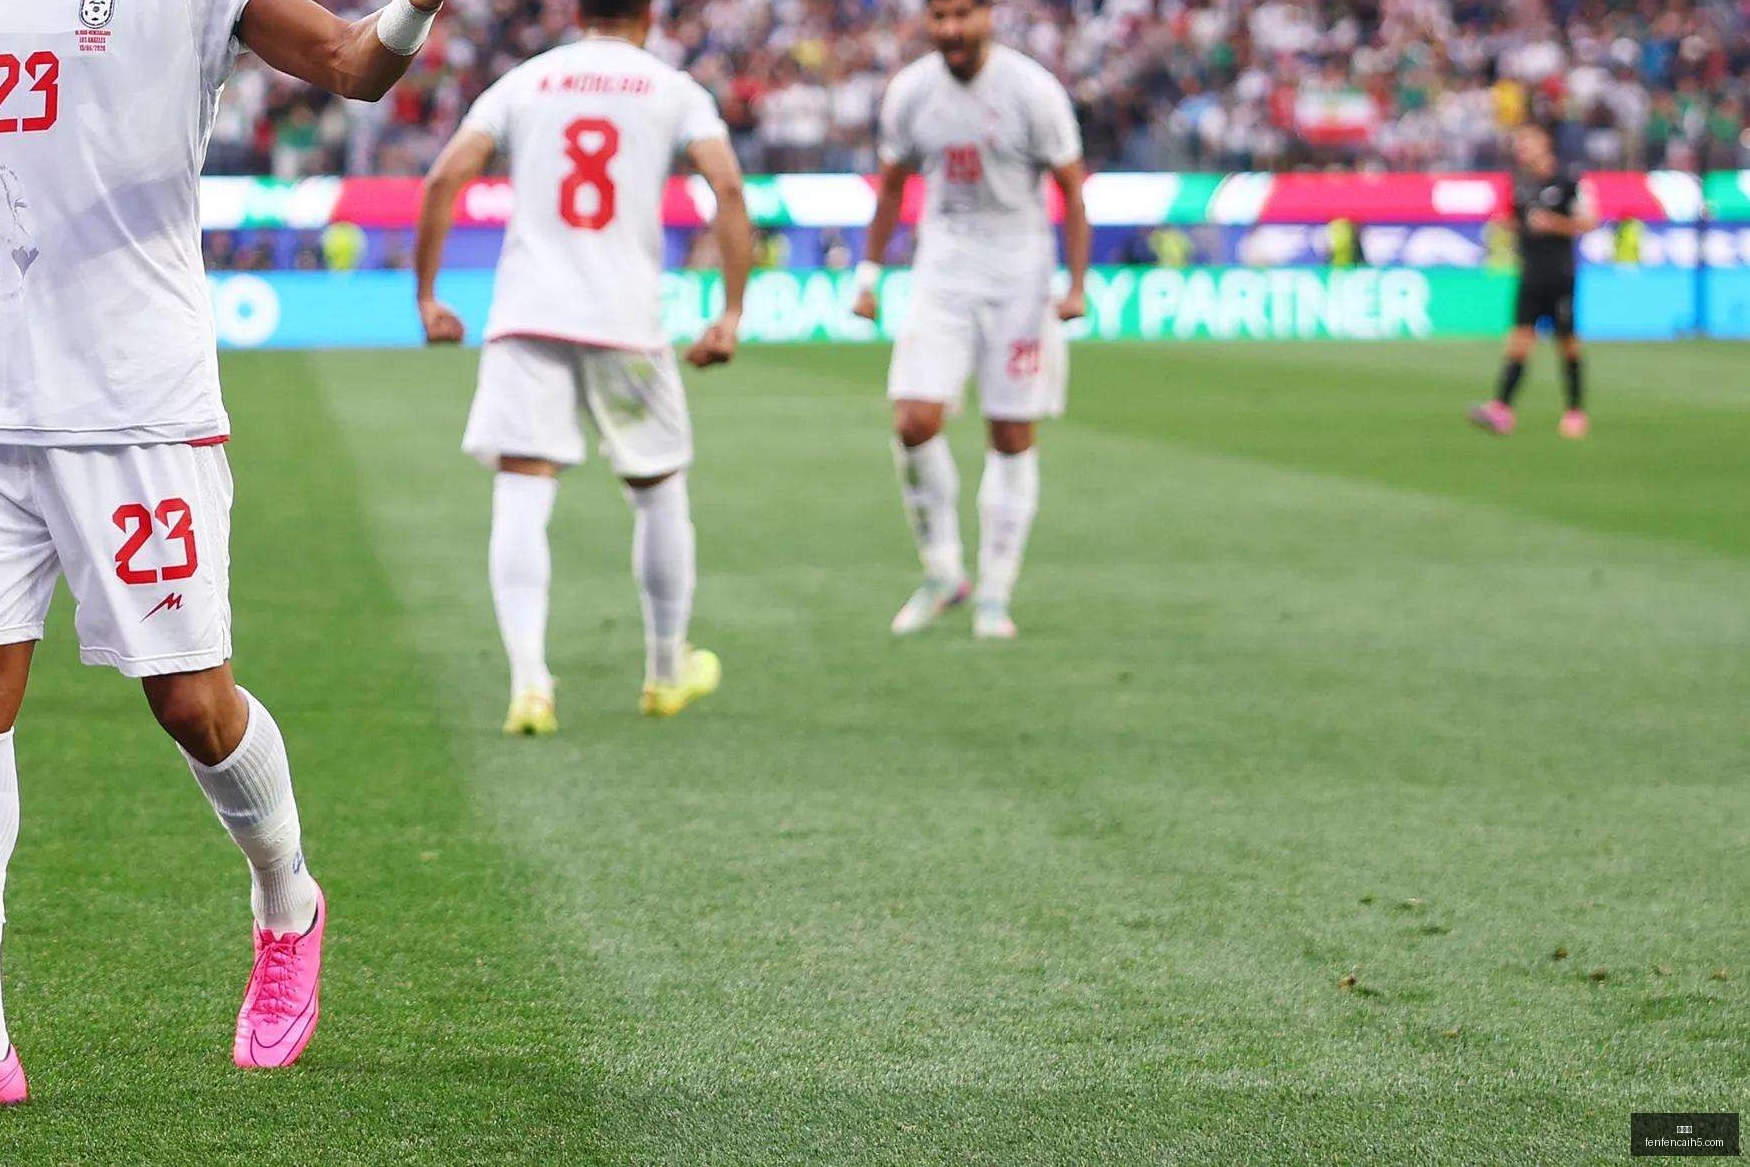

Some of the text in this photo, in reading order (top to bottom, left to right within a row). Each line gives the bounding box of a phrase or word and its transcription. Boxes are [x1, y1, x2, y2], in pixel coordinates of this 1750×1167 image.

[560, 117, 619, 230] 8
[1139, 268, 1433, 340] PARTNER
[112, 497, 198, 584] 23
